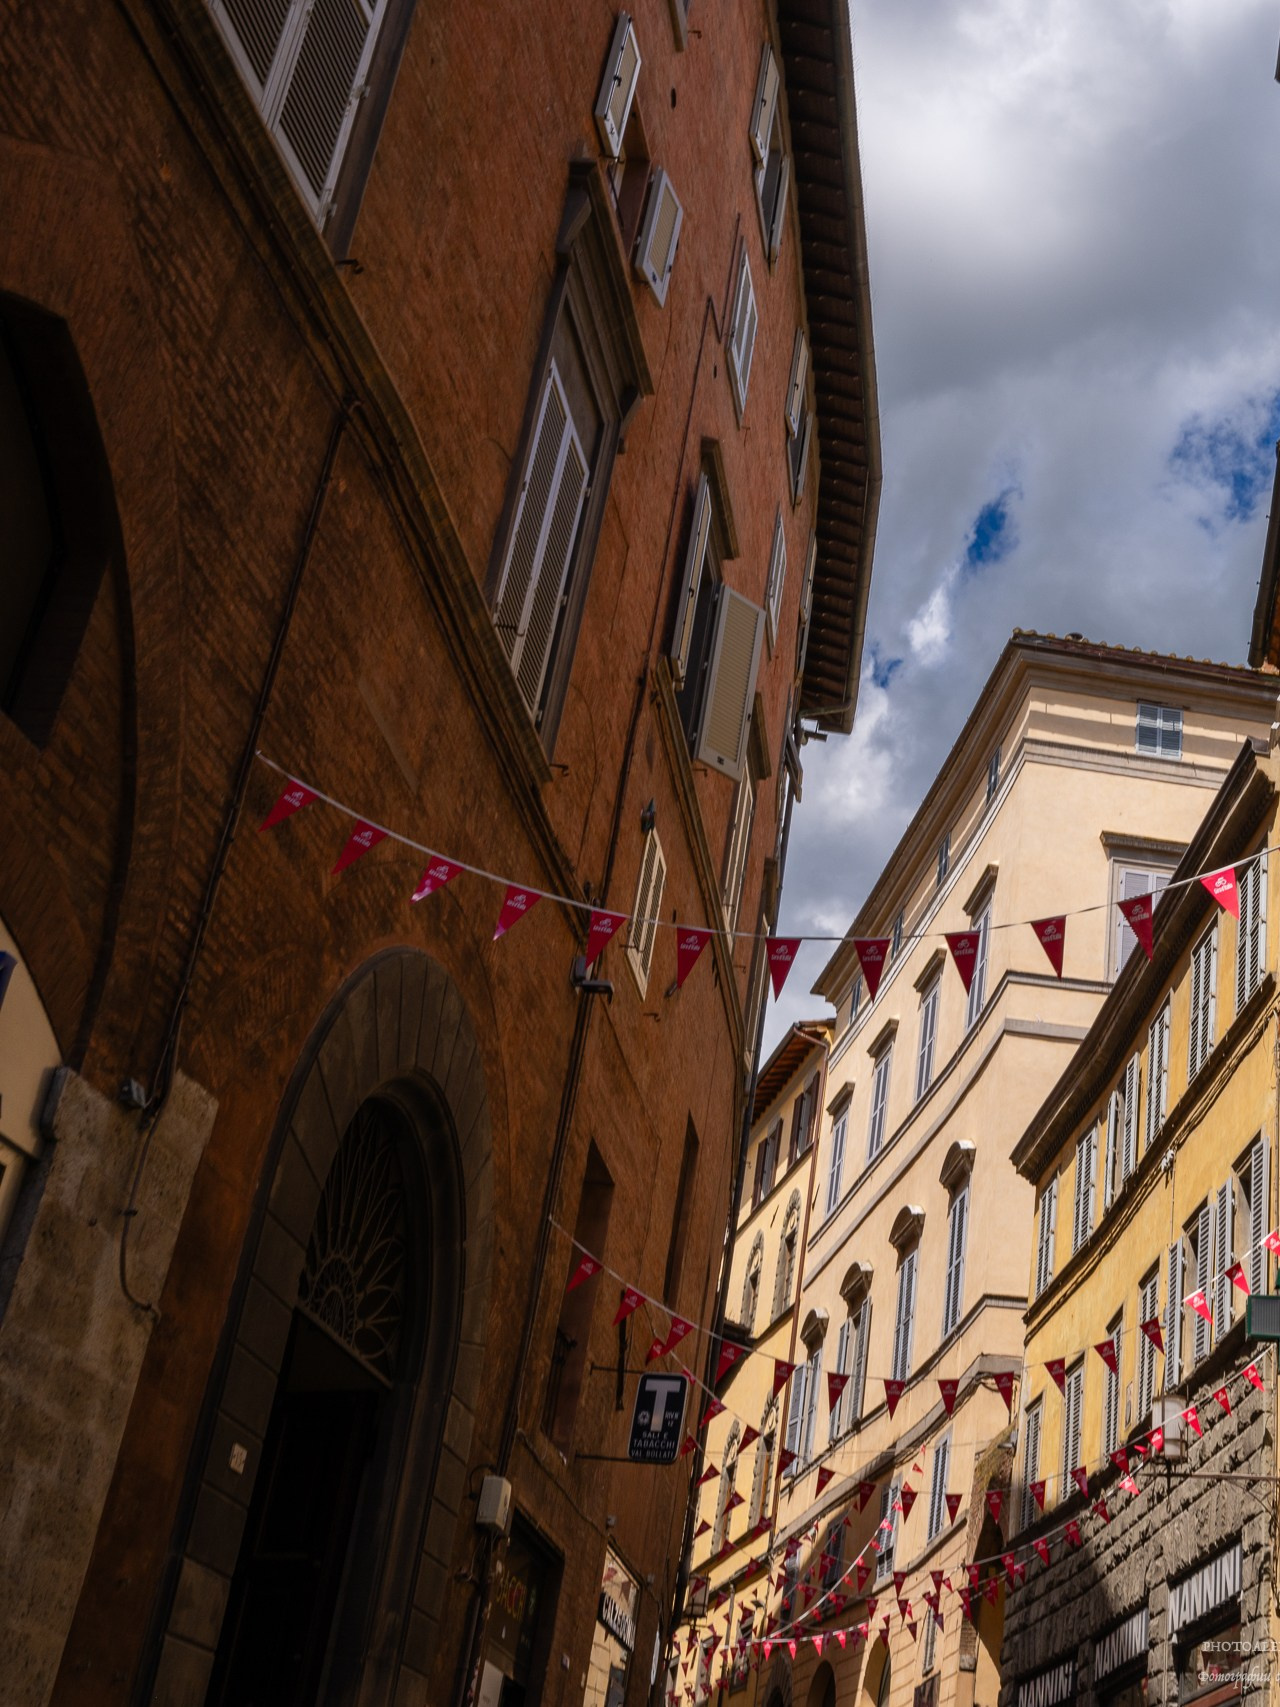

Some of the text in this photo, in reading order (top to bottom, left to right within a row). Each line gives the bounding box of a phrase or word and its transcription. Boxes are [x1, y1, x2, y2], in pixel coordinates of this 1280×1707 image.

[645, 1379, 681, 1432] T
[633, 1438, 675, 1449] TABACCHI
[1169, 1541, 1243, 1640] NANNINI
[1095, 1607, 1149, 1682] NANNINI
